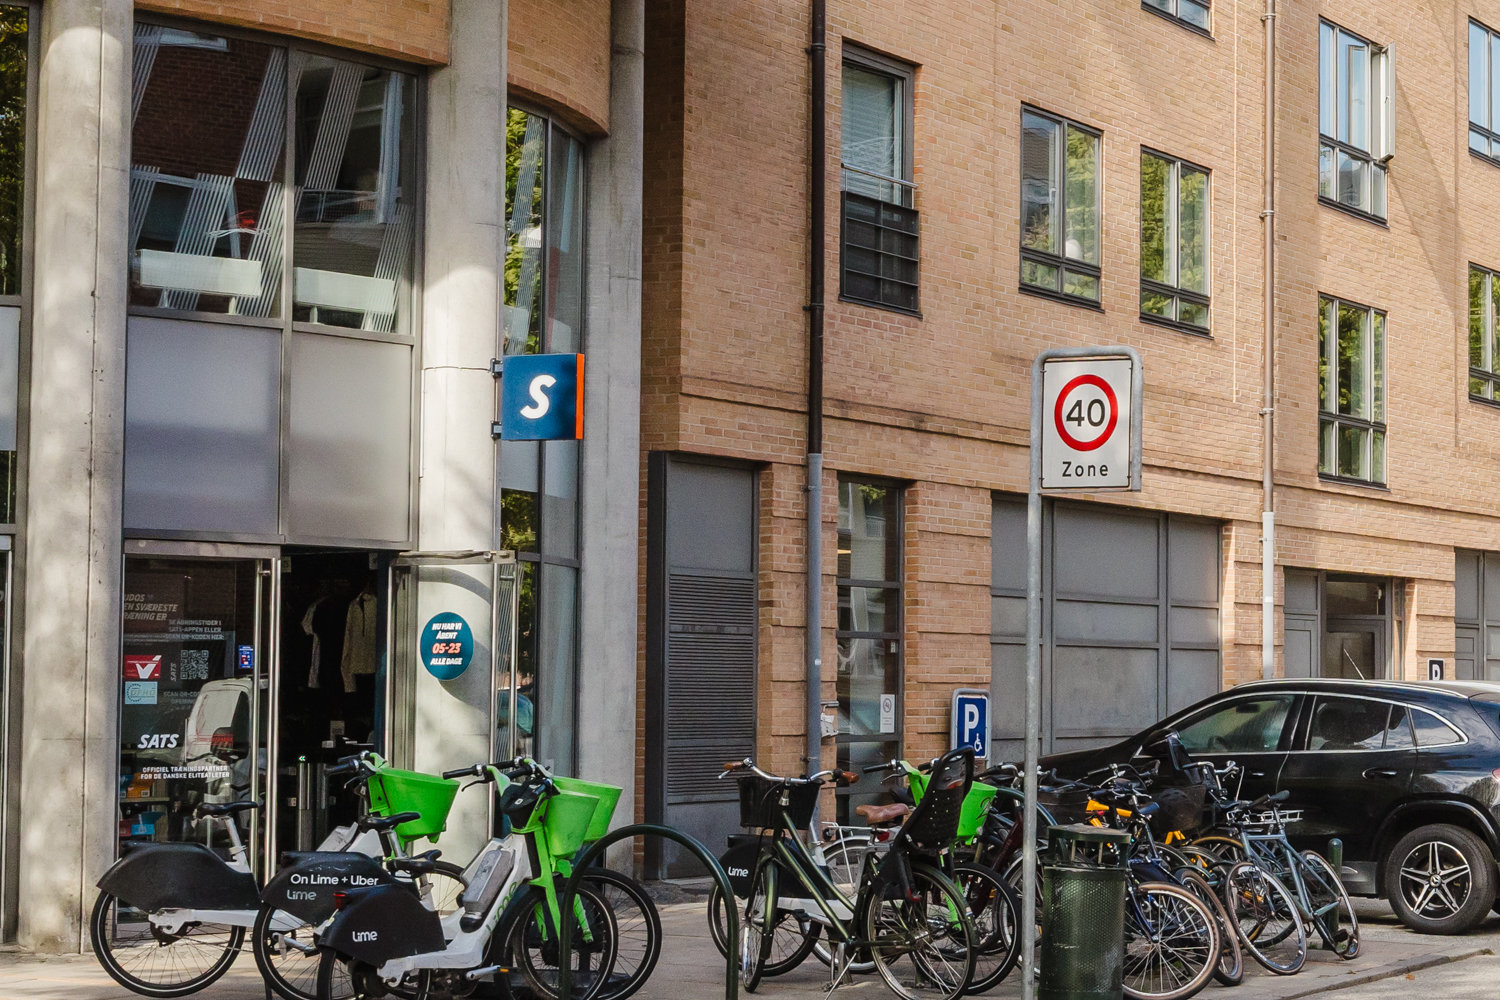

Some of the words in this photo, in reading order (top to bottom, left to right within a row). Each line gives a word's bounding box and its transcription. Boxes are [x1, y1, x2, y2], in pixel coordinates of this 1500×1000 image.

[520, 374, 557, 419] S
[1066, 399, 1105, 427] 40
[1062, 461, 1108, 477] Zone
[432, 643, 461, 654] 05-23
[964, 704, 979, 743] P
[137, 733, 179, 749] SATS
[728, 866, 749, 877] Lime
[290, 873, 309, 885] On
[310, 873, 339, 885] Lime
[341, 876, 348, 884] +
[350, 874, 379, 886] Uber
[286, 888, 317, 901] Lime
[352, 930, 378, 942] Lime
